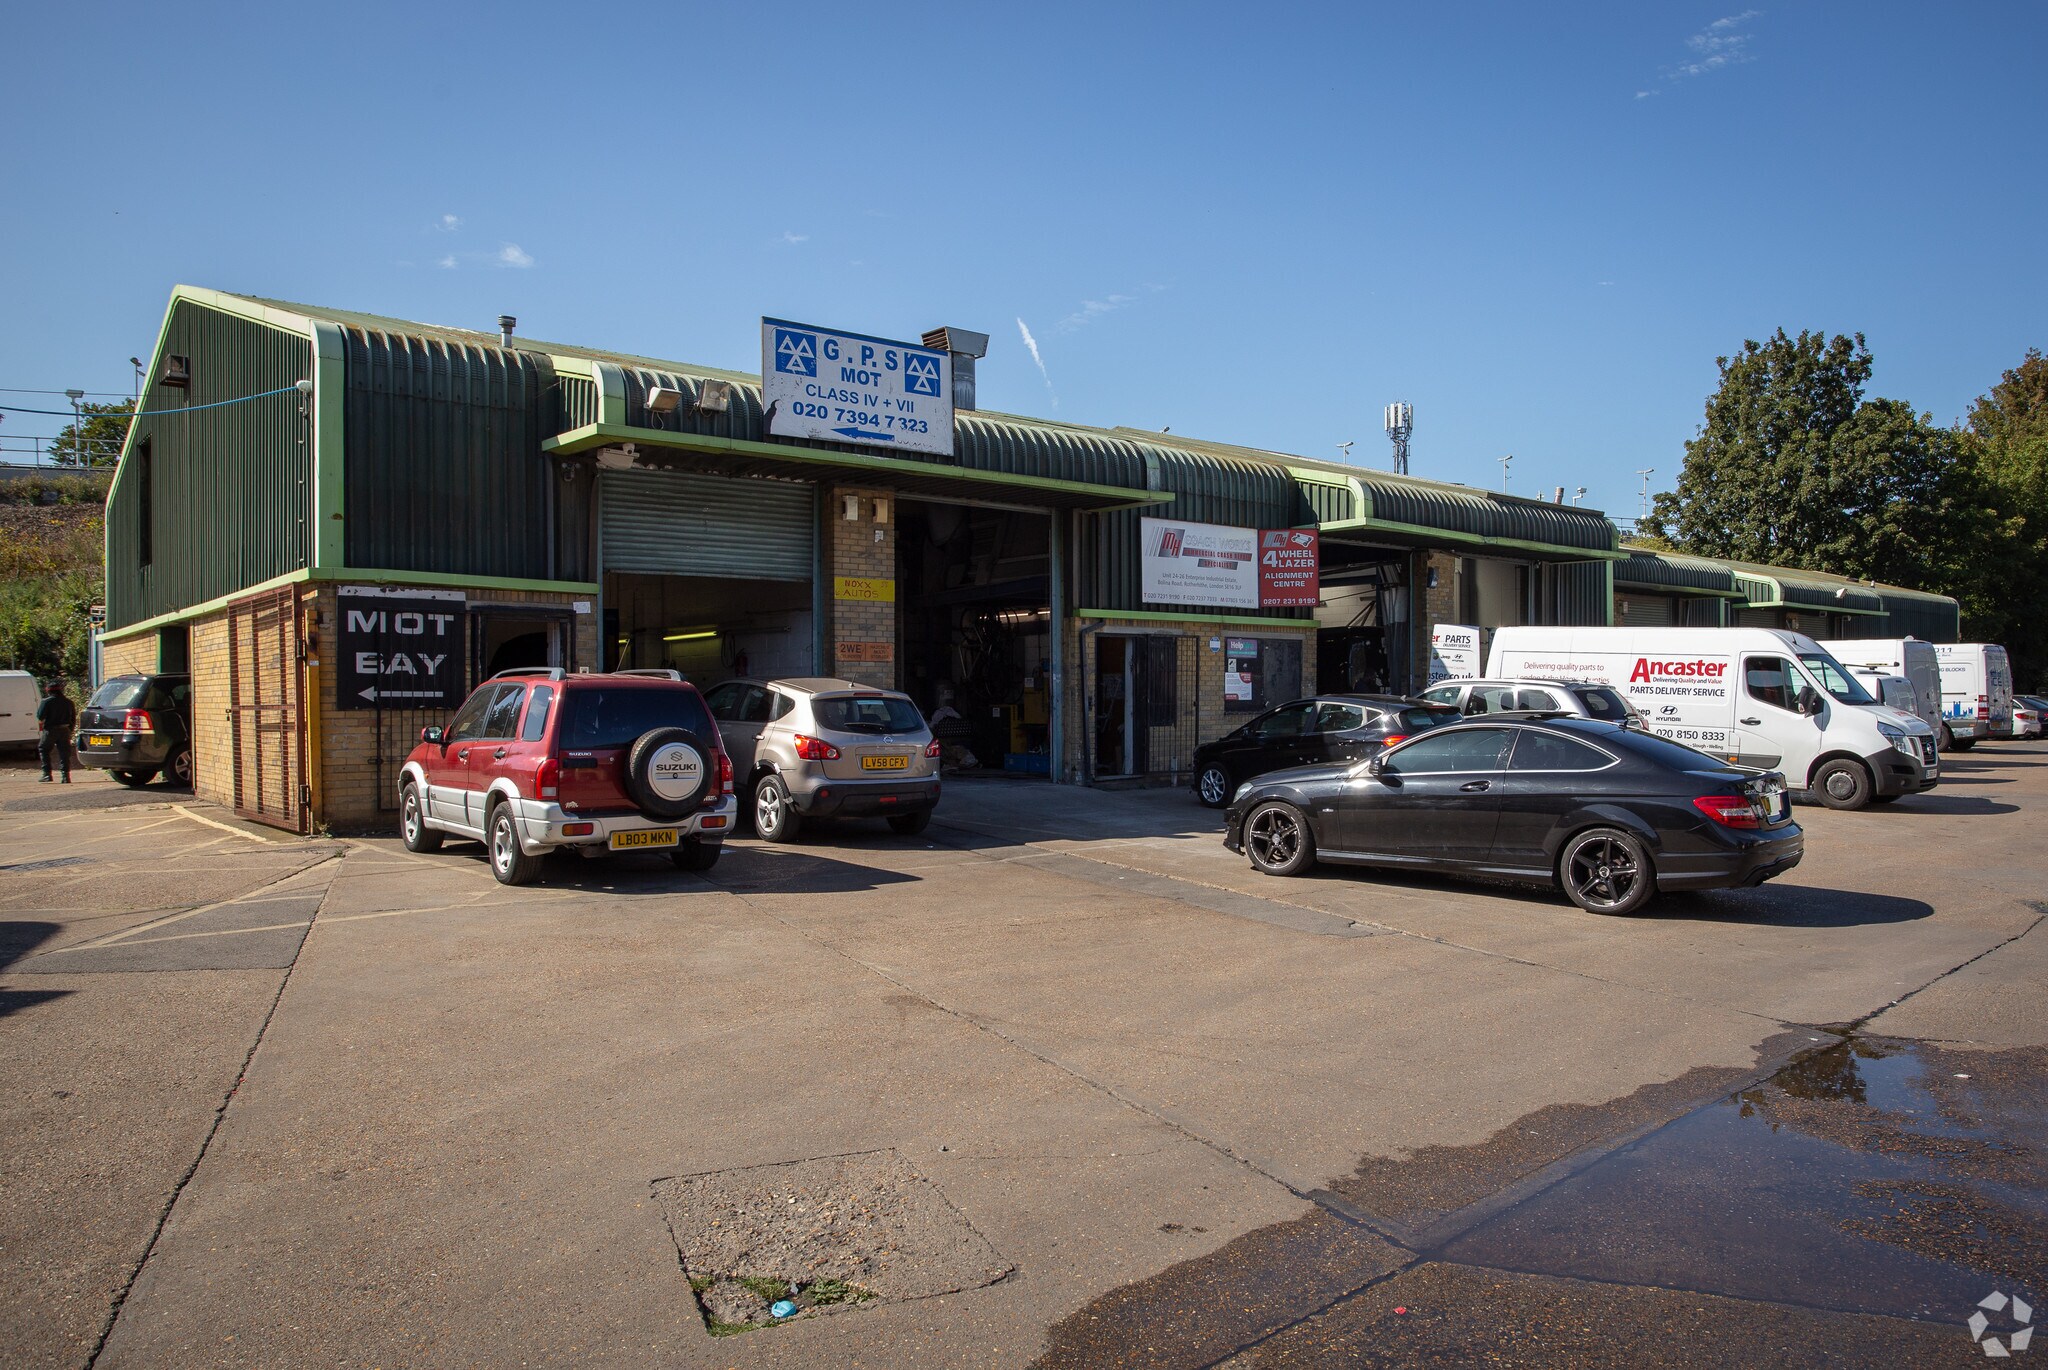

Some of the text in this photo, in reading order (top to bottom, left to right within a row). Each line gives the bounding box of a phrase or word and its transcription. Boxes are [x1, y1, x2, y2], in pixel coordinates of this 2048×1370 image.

[841, 367, 881, 387] MOT
[805, 384, 914, 413] CLASS IV + VII
[793, 401, 928, 434] 020 7394 7323
[1262, 550, 1314, 567] 4 WHEEL
[1185, 574, 1205, 582] Enterprise
[844, 580, 871, 588] NOXX
[843, 589, 879, 598] AUTOS
[347, 610, 454, 636] MOT
[1445, 634, 1471, 644] PARTS
[840, 644, 862, 653] 2WE
[356, 652, 447, 675] BAY
[1524, 661, 1556, 671] Delivering
[1557, 663, 1579, 672] quality
[1629, 658, 1727, 683] Ancaster
[1630, 686, 1725, 697] PARTS DELIVERY SERVICE
[1656, 729, 1725, 741] 020 8150 8333
[656, 763, 696, 771] SUZUKI
[866, 757, 905, 767] LV58 CFX
[617, 831, 672, 846] LB03 MKN
